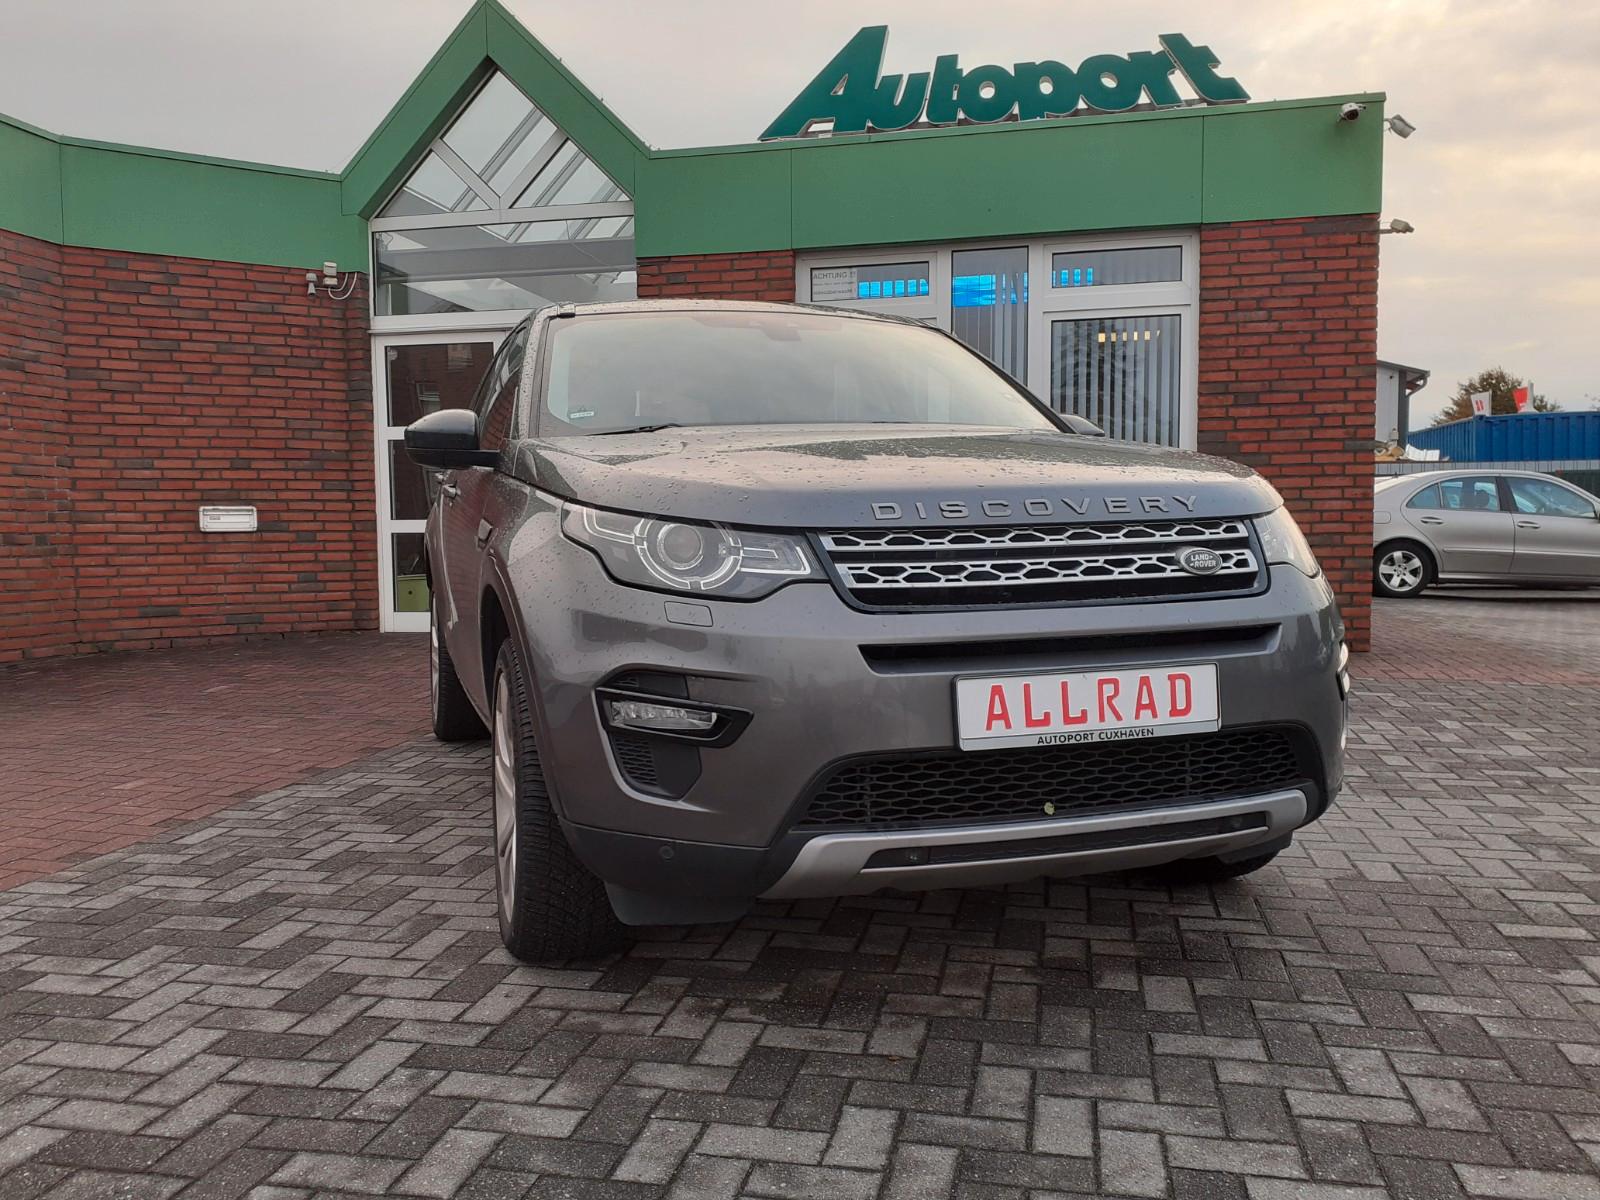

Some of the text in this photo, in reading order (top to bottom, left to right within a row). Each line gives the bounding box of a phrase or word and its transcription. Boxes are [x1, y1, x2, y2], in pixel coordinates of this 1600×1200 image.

[758, 25, 1251, 140] Autoport
[813, 272, 847, 280] ACHTUNG
[871, 495, 1197, 521] DISCOVERY
[1190, 553, 1209, 561] LAND
[1194, 559, 1217, 568] ROVER
[985, 673, 1192, 731] ALLRAD
[1037, 727, 1155, 745] AUTOPORT CUXHAVEN
